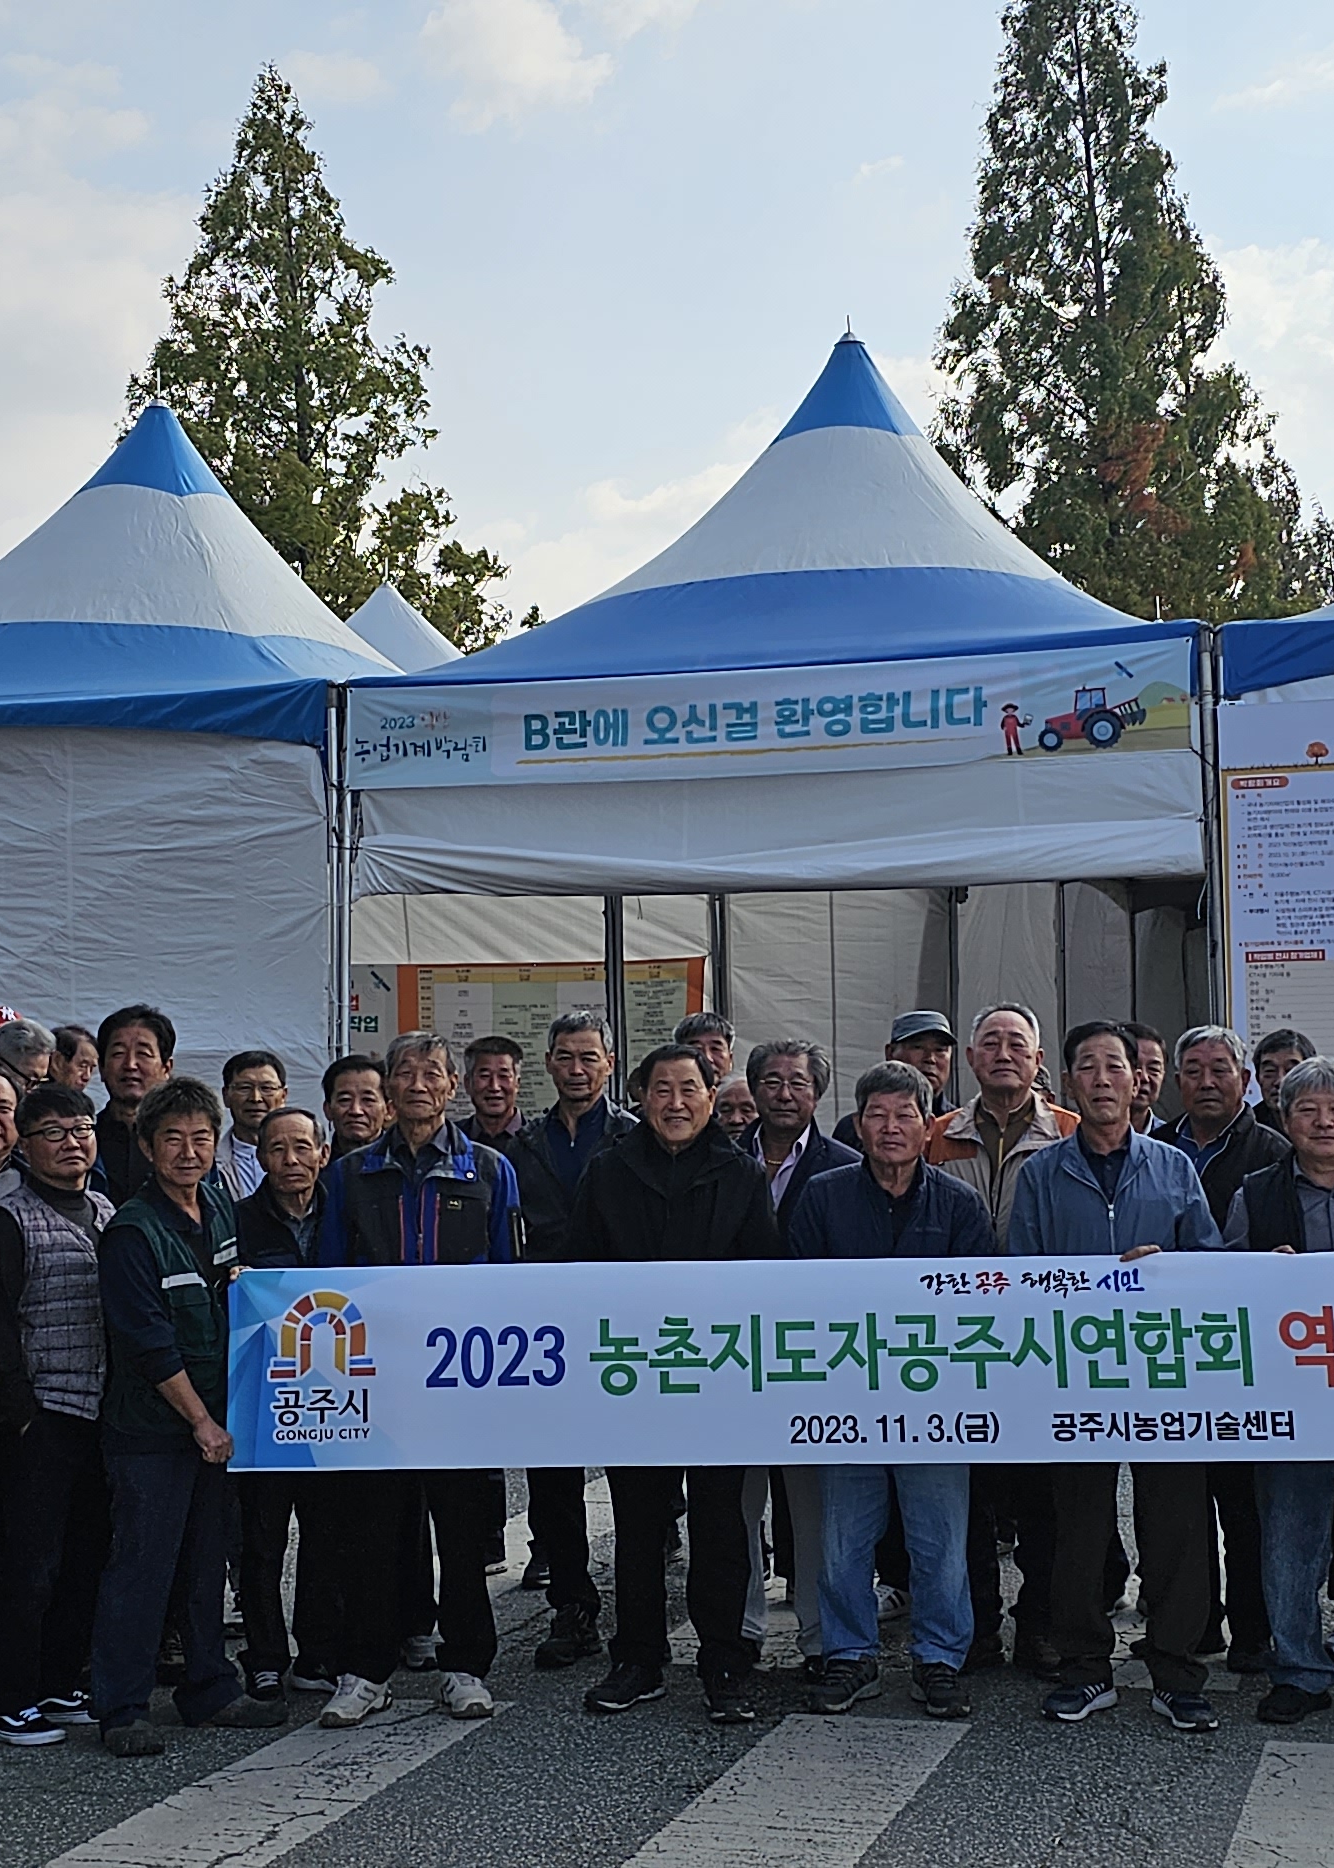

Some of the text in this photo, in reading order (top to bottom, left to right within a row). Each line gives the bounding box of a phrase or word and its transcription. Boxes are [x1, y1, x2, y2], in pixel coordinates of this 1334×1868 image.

[380, 716, 416, 730] 2023
[523, 686, 988, 751] B관에 오신걸 환영합니다
[354, 736, 487, 763] 농업기계 박람회
[919, 1267, 1145, 1299] 강한 공주 행복한 시민
[425, 1325, 567, 1390] 2023
[589, 1306, 1253, 1396] 농촌지도자공주시연합회
[272, 1388, 369, 1427] 공주시
[275, 1427, 370, 1443] GONGJU CITY
[789, 1411, 1296, 1445] 2023. 11. 3.(금) 공주시농업기술센터
